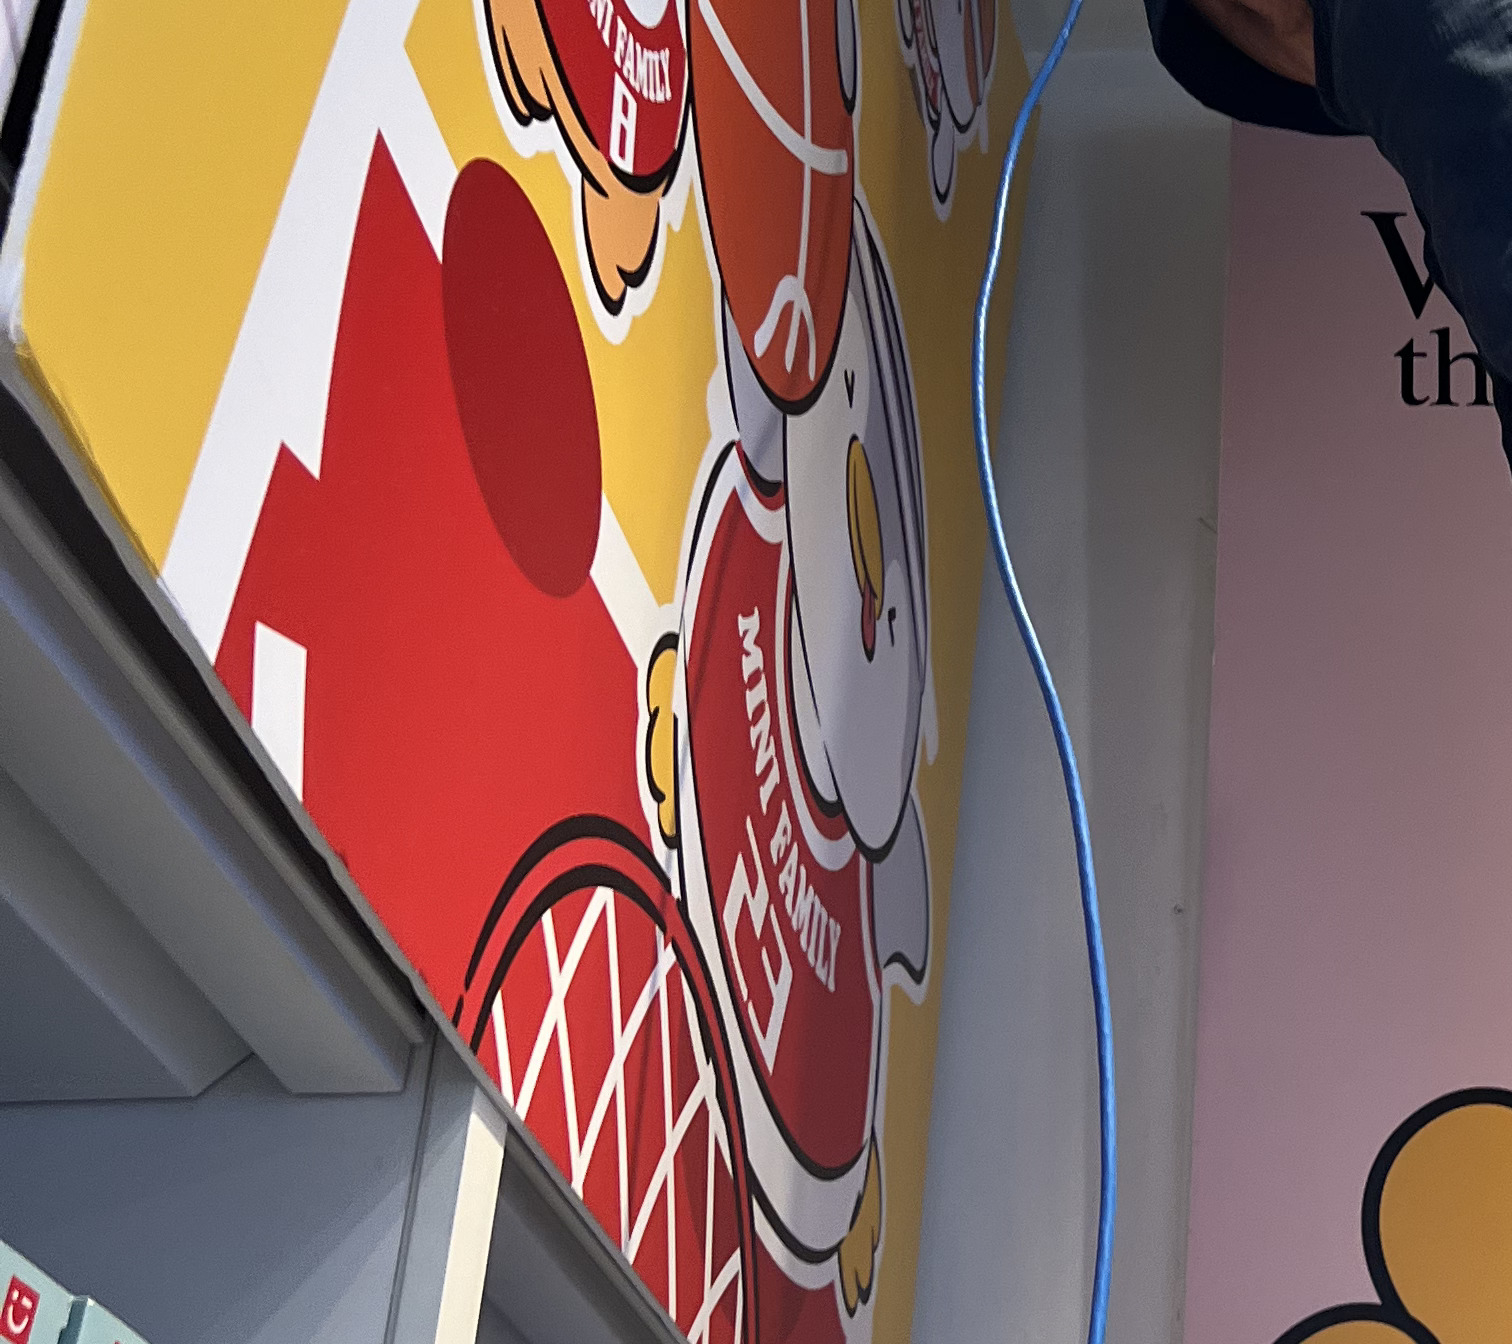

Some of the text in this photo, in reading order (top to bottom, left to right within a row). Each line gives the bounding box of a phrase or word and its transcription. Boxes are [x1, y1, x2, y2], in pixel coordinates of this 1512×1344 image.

[614, 15, 672, 104] FAMILY
[1393, 327, 1494, 407] th
[738, 607, 842, 994] MINI FAMILY
[723, 816, 793, 1077] 23
